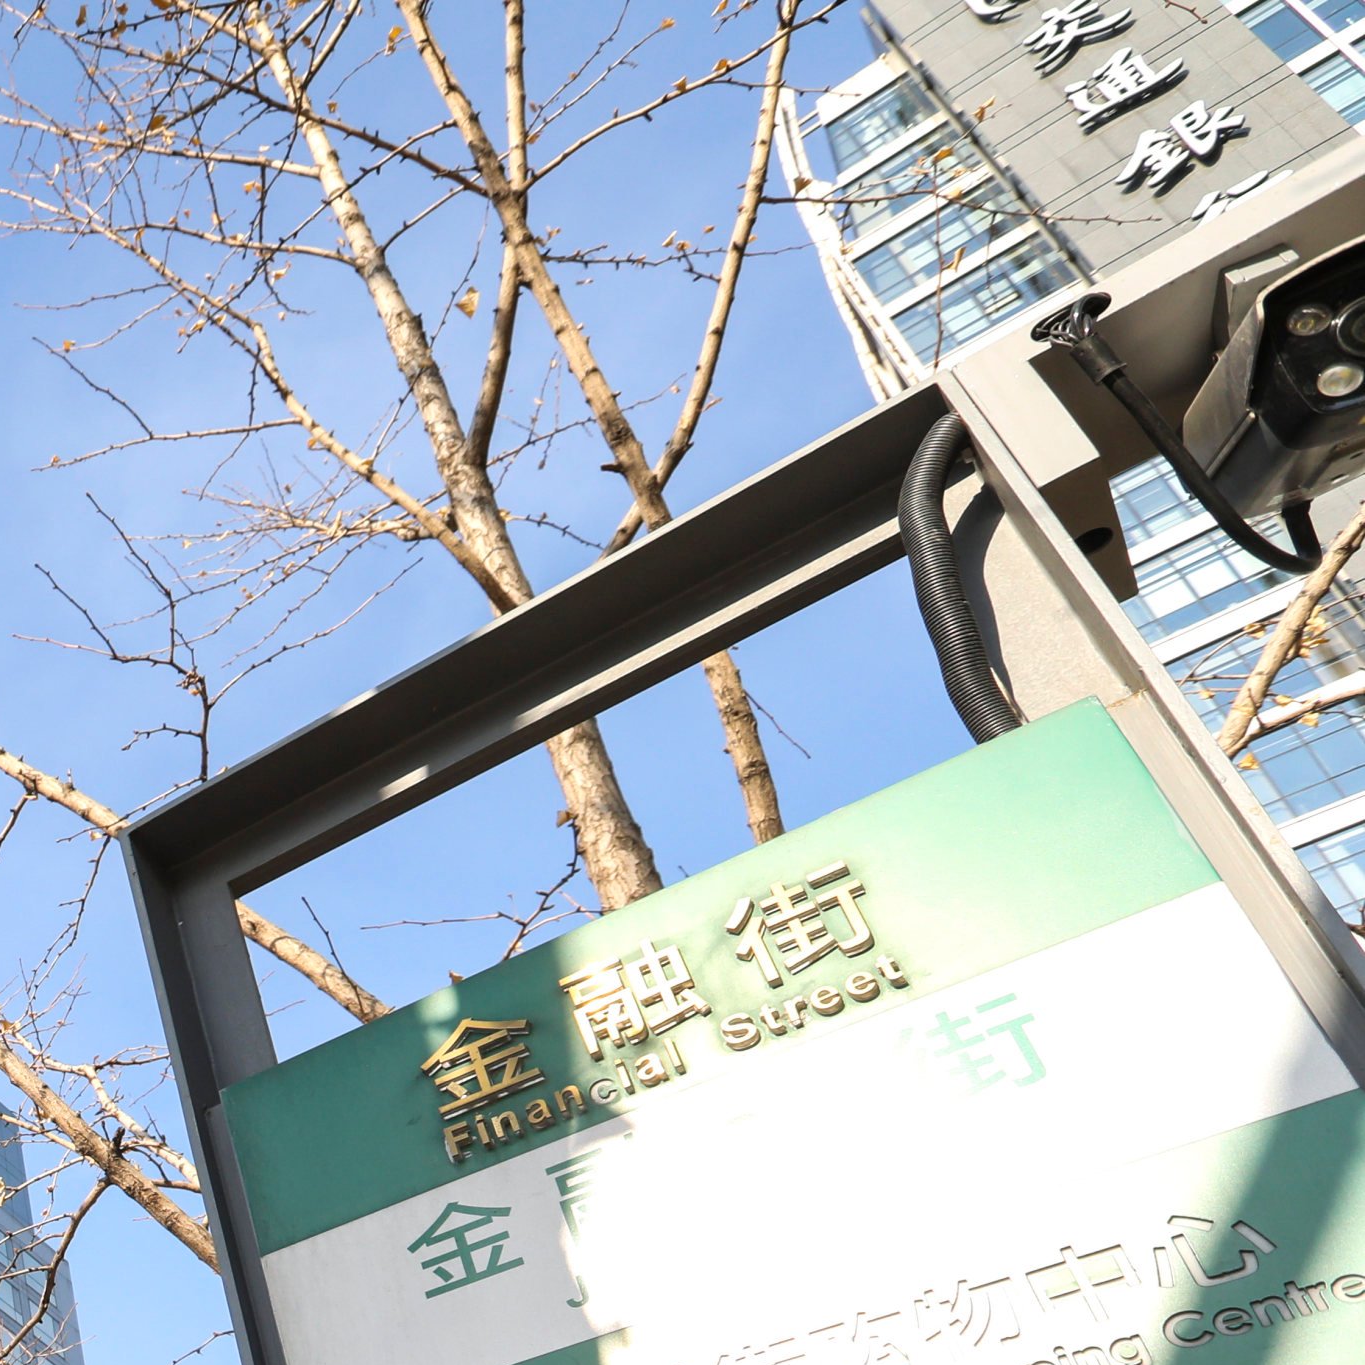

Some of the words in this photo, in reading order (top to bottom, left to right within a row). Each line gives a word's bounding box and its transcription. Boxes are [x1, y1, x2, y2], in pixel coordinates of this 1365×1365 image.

[421, 859, 876, 1120] 金融街
[442, 1038, 687, 1163] Financial
[719, 954, 911, 1051] Street
[1162, 1273, 1365, 1349] Centre
